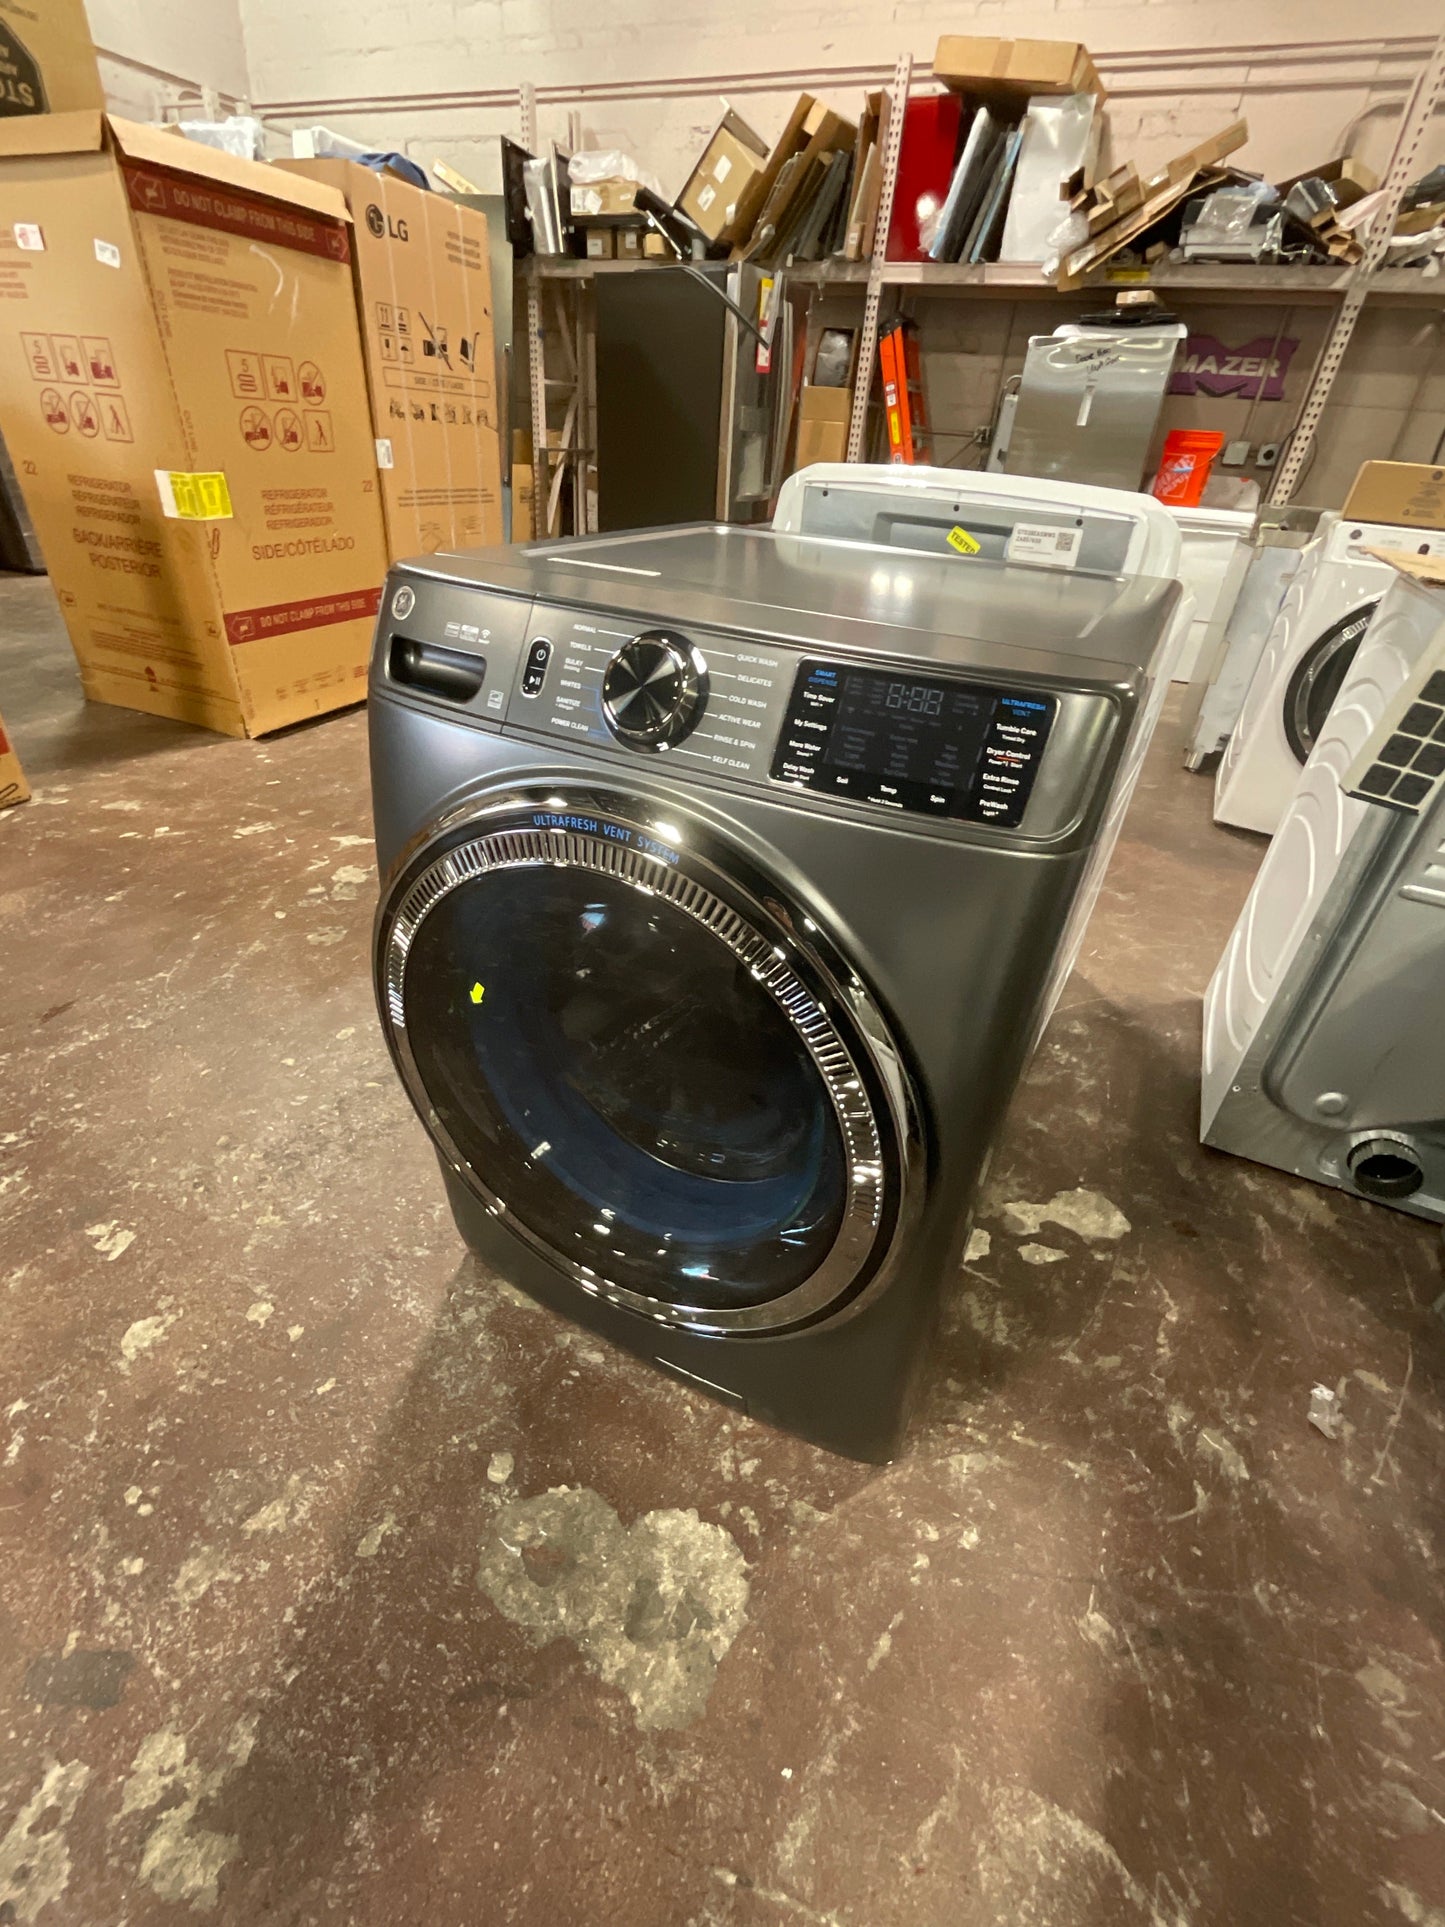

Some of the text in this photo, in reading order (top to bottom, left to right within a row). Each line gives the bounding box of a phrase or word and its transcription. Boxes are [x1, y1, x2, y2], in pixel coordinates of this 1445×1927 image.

[172, 187, 190, 207] DO
[190, 193, 213, 213] NOT
[213, 199, 248, 222] CLAMP
[247, 208, 276, 230] FROM
[387, 214, 409, 242] LG
[1174, 353, 1281, 378] MAZER
[261, 487, 328, 500] REFRIGERATOR
[950, 531, 977, 555] TESTED
[89, 552, 162, 579] POSTERIOR
[260, 615, 273, 628] DO
[273, 612, 289, 625] NOT
[289, 607, 315, 622] CLAMP
[315, 604, 335, 616] FROM
[573, 624, 597, 633] NORMAL
[570, 641, 592, 651] TOWELS
[565, 657, 584, 667] BULKY
[736, 653, 778, 668] QUICK WASH
[815, 669, 837, 678] SMART
[560, 679, 582, 689] WHITES
[737, 674, 773, 687] DELICATES
[556, 696, 581, 707] SANITIZE
[728, 694, 767, 709] COLD WASH
[803, 691, 818, 700] Time
[1001, 698, 1047, 711] ULTRAFRESH
[551, 717, 589, 732] POWER CLEAN
[718, 714, 761, 729] ACTIVE WEAR
[794, 718, 828, 731] My Settings
[996, 723, 1038, 737] Tumble Care
[713, 734, 733, 745] RINSE
[739, 739, 756, 750] SPIN
[789, 740, 804, 749] More
[986, 747, 1032, 760] Dryer Control
[712, 755, 750, 770] SELF CLEAN
[783, 762, 815, 775] Delay Wash
[982, 772, 1020, 786] Extra Rinse
[930, 794, 946, 804] Spin
[533, 814, 680, 865] ULTRAFRESH VENT SYSTEM
